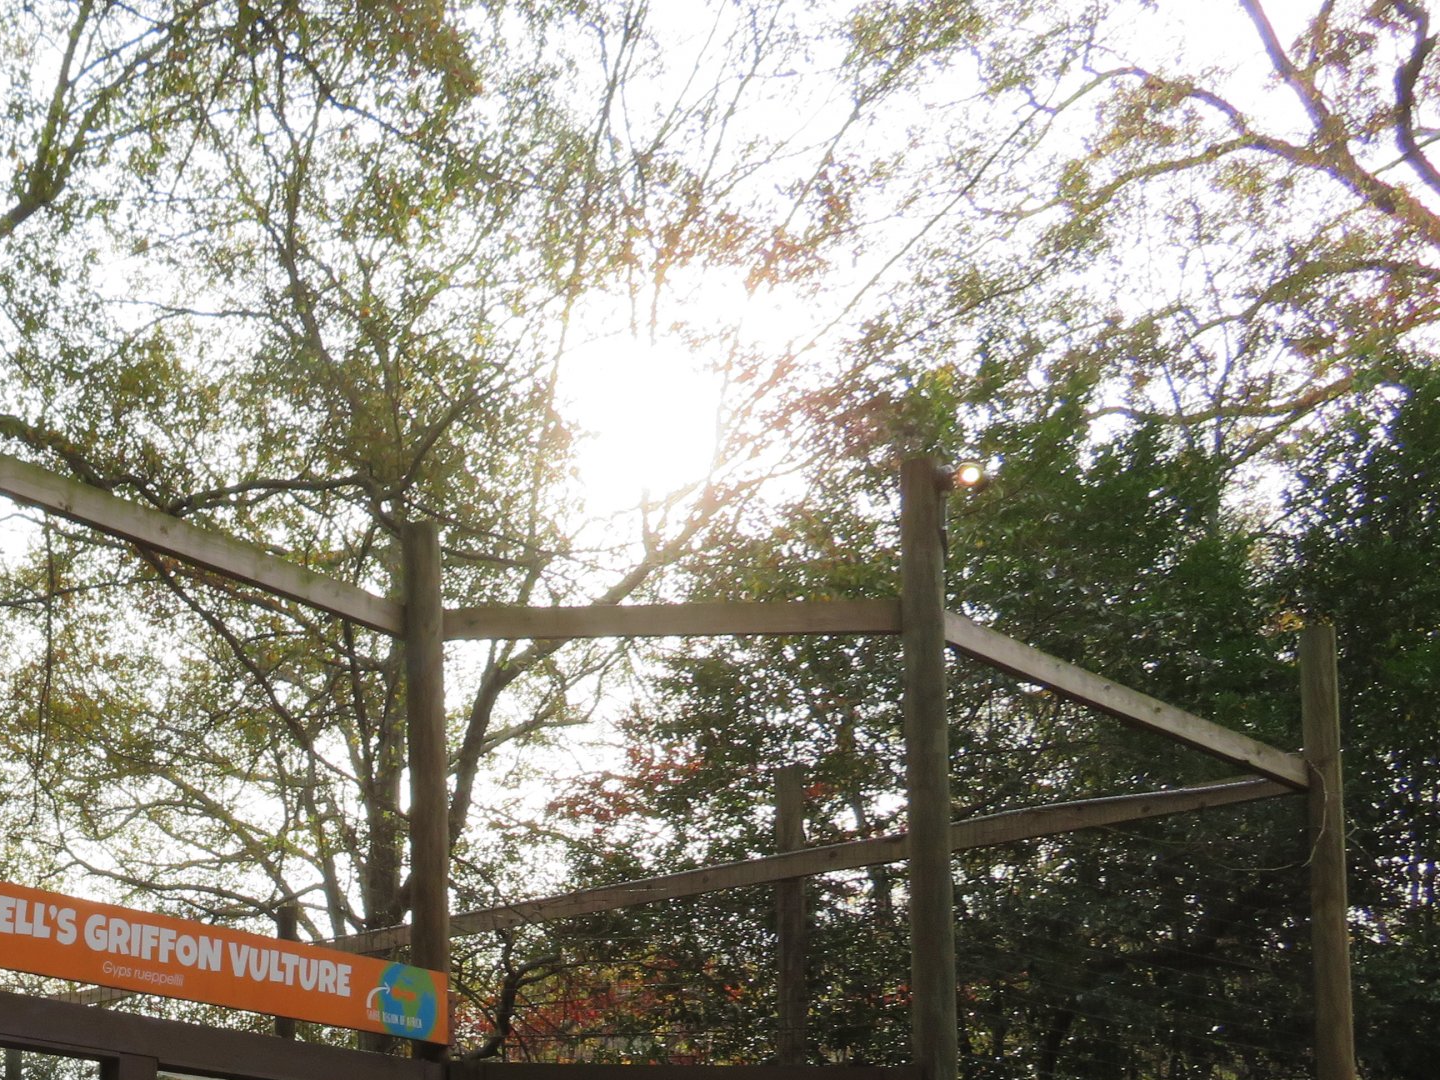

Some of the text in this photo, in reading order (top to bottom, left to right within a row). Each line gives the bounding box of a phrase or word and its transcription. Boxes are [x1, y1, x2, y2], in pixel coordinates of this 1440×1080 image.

[84, 914, 222, 972] GRIFFON
[228, 942, 351, 997] VULTURE
[102, 960, 132, 979] Gyps
